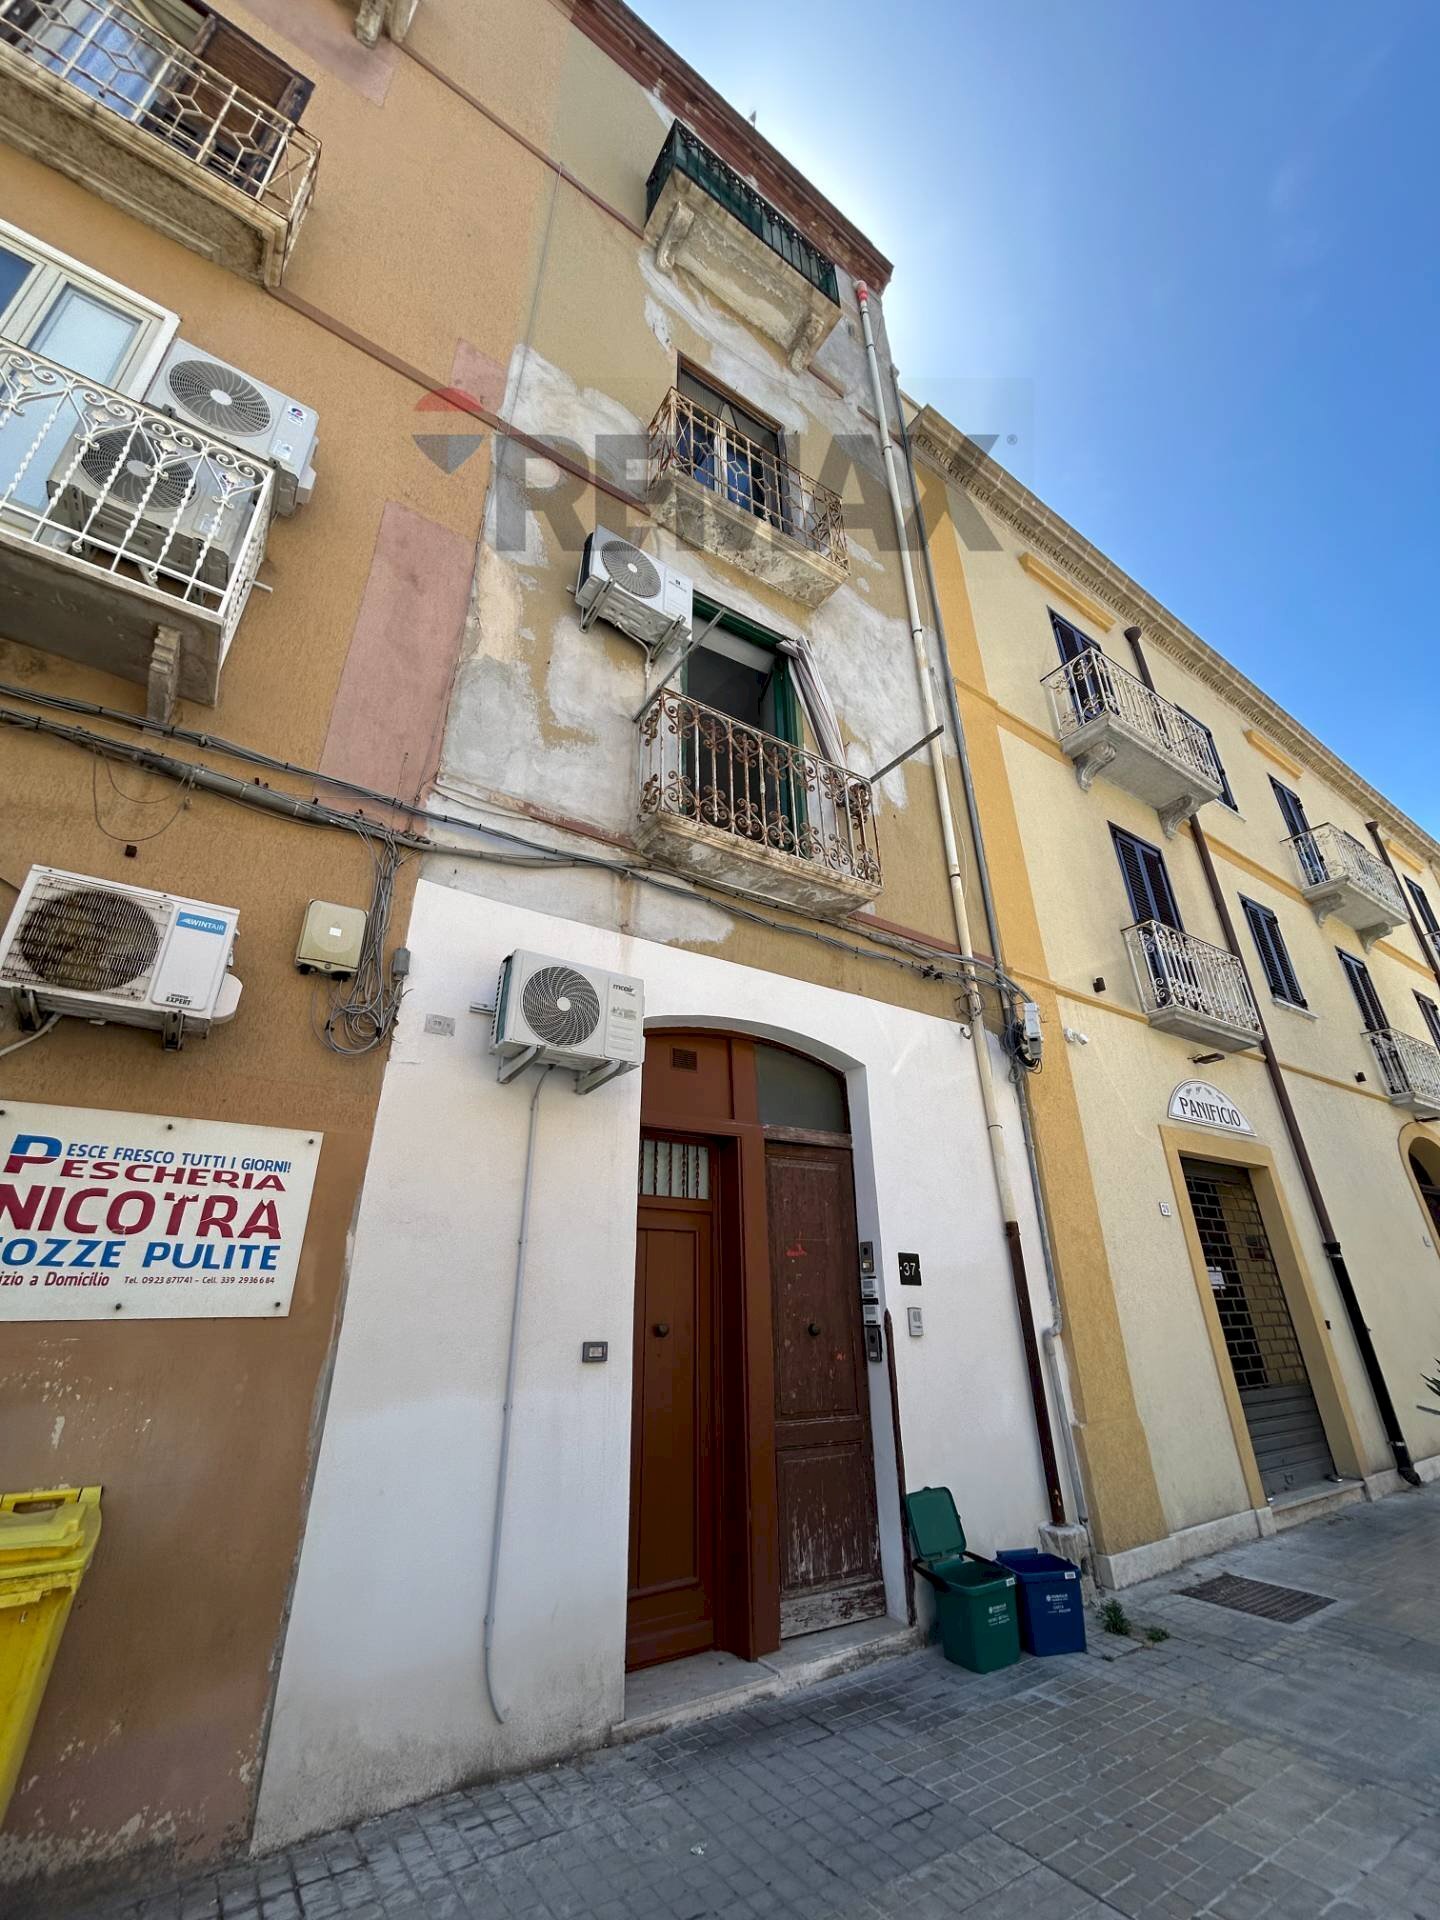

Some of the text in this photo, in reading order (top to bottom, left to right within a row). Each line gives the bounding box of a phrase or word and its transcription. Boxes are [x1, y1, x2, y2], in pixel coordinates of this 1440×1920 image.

[191, 918, 224, 931] WINTAIR
[1178, 1096, 1241, 1127] PANIFICIO
[113, 1147, 174, 1164] FRESCO
[182, 1152, 227, 1168] TUTTI
[230, 1156, 236, 1170] I
[241, 1157, 291, 1173] GIORNI!
[0, 1183, 282, 1240] NICOTRA
[0, 1236, 281, 1271] OZZE PULITE
[29, 1275, 39, 1287] a
[44, 1271, 110, 1287] Domicilio
[903, 1262, 916, 1276] 37
[221, 1276, 234, 1285] 339
